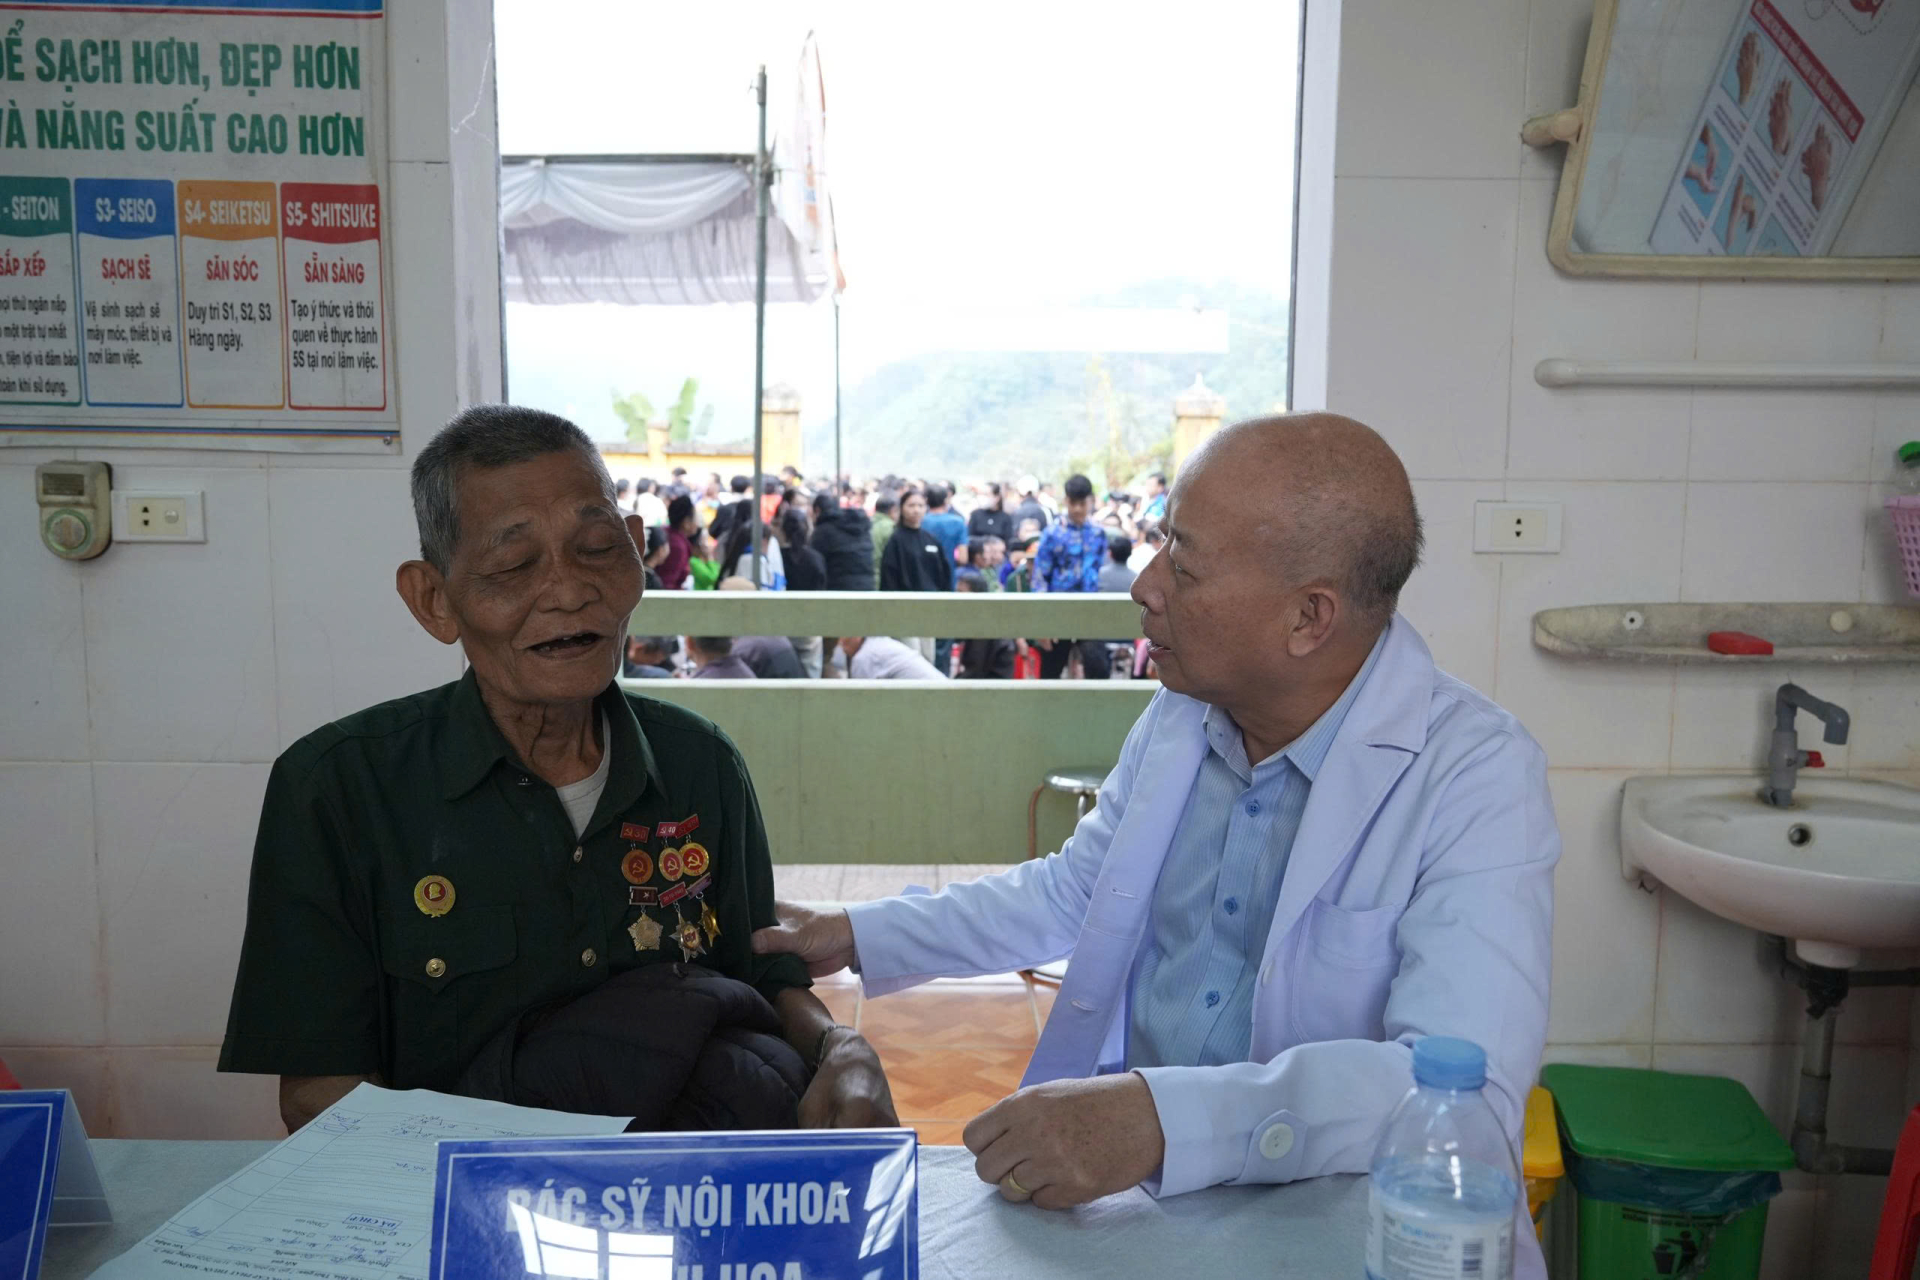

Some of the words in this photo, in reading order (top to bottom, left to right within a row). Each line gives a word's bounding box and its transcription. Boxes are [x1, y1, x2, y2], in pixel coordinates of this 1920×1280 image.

[0, 18, 25, 82] Ể
[35, 37, 122, 93] SẠCH
[132, 36, 210, 92] HƠN,
[220, 43, 282, 97] ĐẸP
[293, 41, 361, 90] HƠN
[0, 98, 27, 149] À
[35, 100, 125, 151] NĂNG
[135, 97, 216, 153] SUẤT
[227, 112, 288, 155] CAO
[298, 112, 365, 157] HƠN
[11, 196, 60, 221] SEITON
[95, 197, 116, 222] S3-
[118, 197, 157, 223] SEISO
[185, 200, 206, 224] S4-
[209, 200, 271, 226] SEIKETSU
[286, 201, 308, 227] S5-
[311, 202, 376, 228] SHITSUKE
[23, 250, 46, 276] XẾP
[101, 258, 136, 286] SẠCH
[138, 254, 151, 280] SẼ
[206, 254, 229, 281] SĂN
[233, 254, 259, 282] SÓC
[304, 251, 329, 283] SẴN
[331, 257, 365, 285] SÀNG
[84, 301, 97, 321] Vệ
[101, 301, 121, 318] sinh
[125, 301, 145, 322] sạch
[188, 301, 208, 325] Duy
[222, 302, 239, 324] S1,
[240, 302, 257, 324] S2,
[258, 302, 272, 322] S3
[291, 299, 310, 322] Tạo
[311, 300, 317, 322] ý
[319, 300, 341, 318] thức
[343, 300, 355, 319] và
[87, 324, 105, 345] máy
[161, 325, 172, 342] và
[188, 327, 214, 352] Hàng
[217, 328, 243, 352] ngày.
[292, 328, 315, 347] quen
[317, 321, 329, 343] về
[331, 326, 353, 347] thực
[355, 326, 378, 344] hành
[293, 350, 305, 368] 5S
[307, 350, 319, 372] tại
[338, 350, 355, 369] làm
[357, 350, 379, 373] việc.
[600, 1177, 652, 1230] SỸ
[664, 1175, 732, 1237] NỘI
[746, 1181, 851, 1226] KHOA
